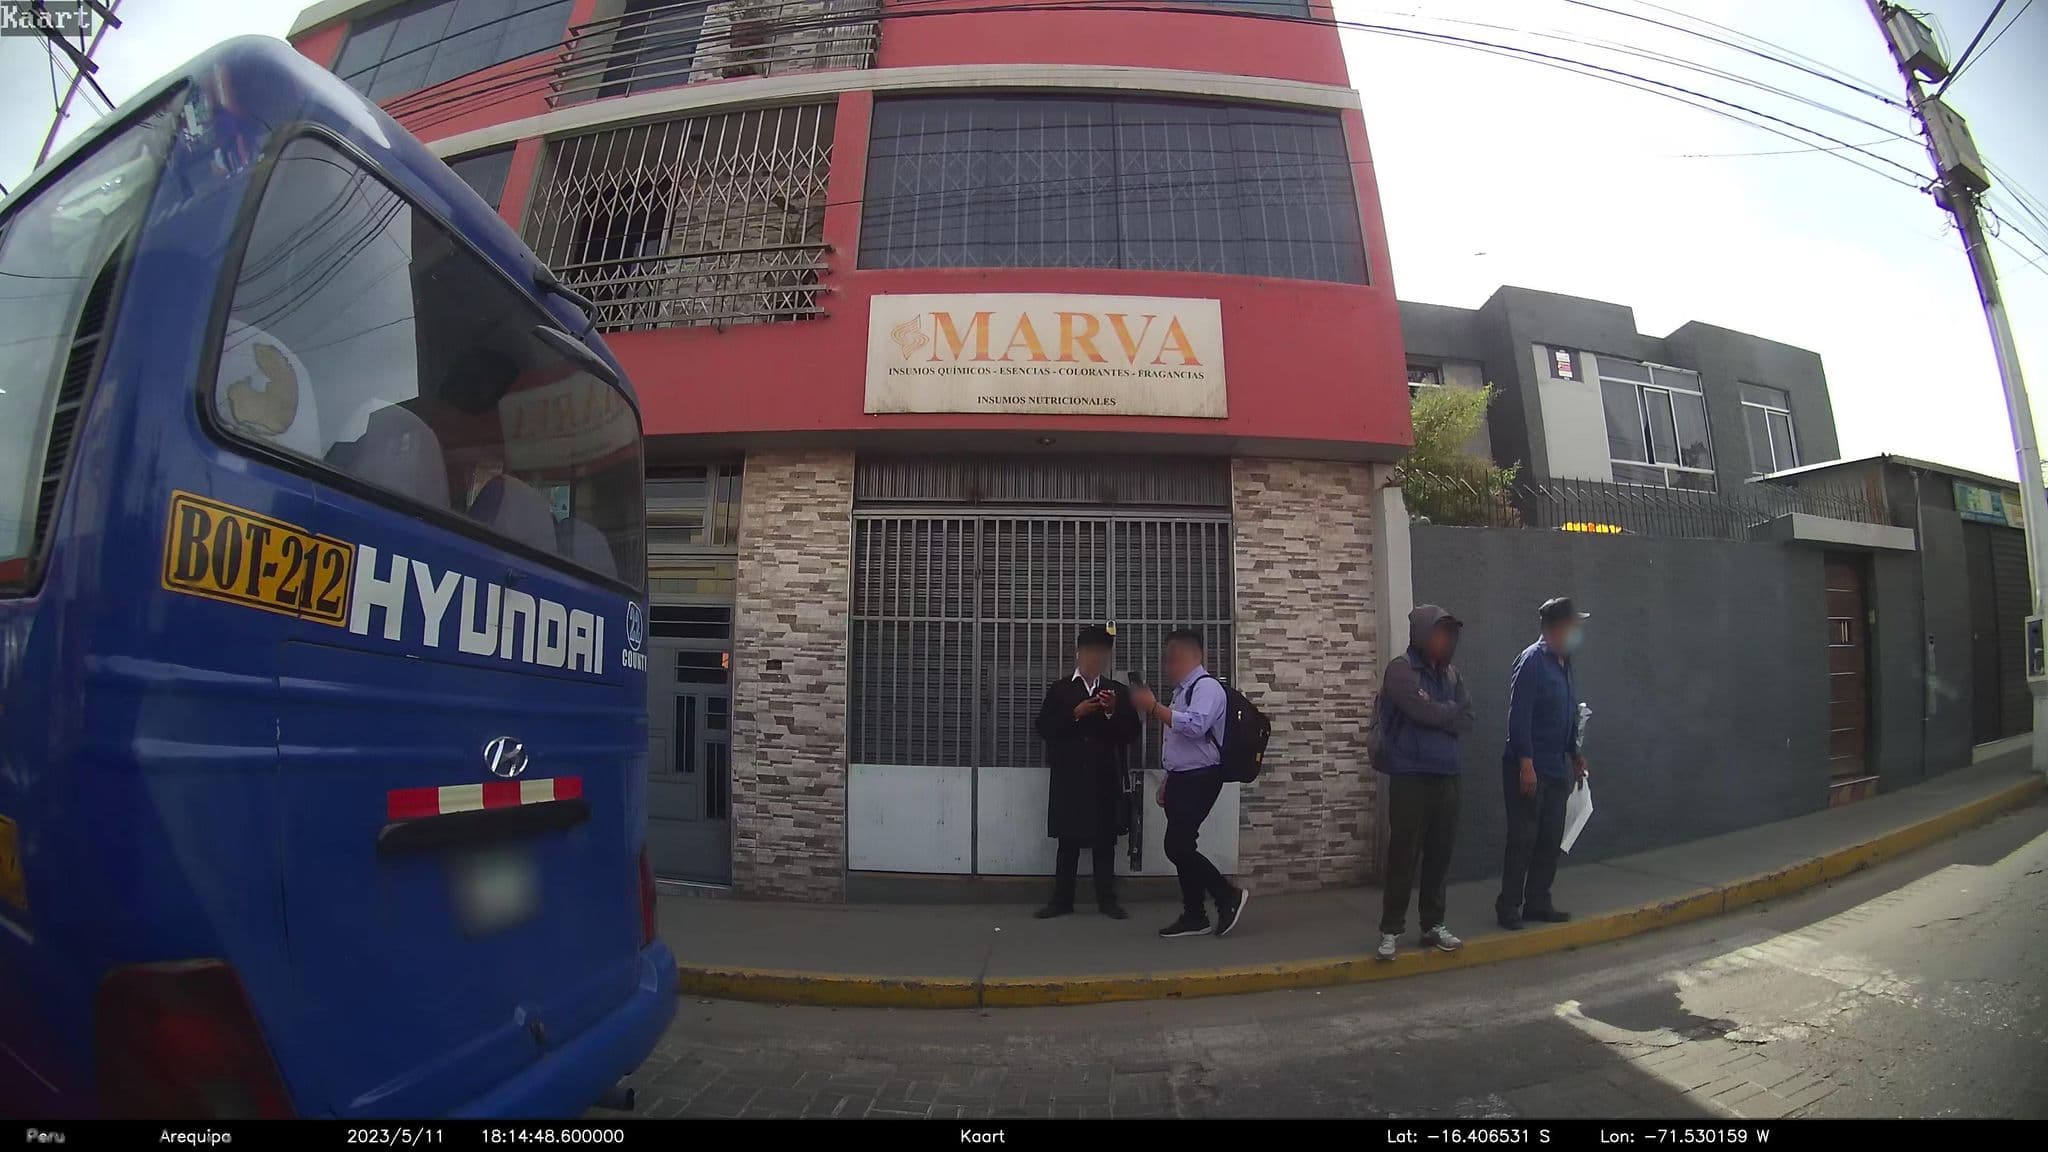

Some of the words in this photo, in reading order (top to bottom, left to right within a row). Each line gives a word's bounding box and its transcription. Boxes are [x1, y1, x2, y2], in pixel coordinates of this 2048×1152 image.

[926, 311, 1204, 366] MARVA
[889, 367, 935, 376] INSUMOS
[937, 365, 991, 377] QUÍMICOS
[1000, 367, 1050, 376] ESENCIAS
[1058, 367, 1130, 378] COLORANTES
[1138, 369, 1205, 380] FRAGANCIAS
[977, 395, 1026, 405] INSUMOS
[1028, 396, 1117, 407] NUTRICIONALES
[174, 503, 345, 611] BOT-212
[349, 544, 606, 675] HYUNDAI
